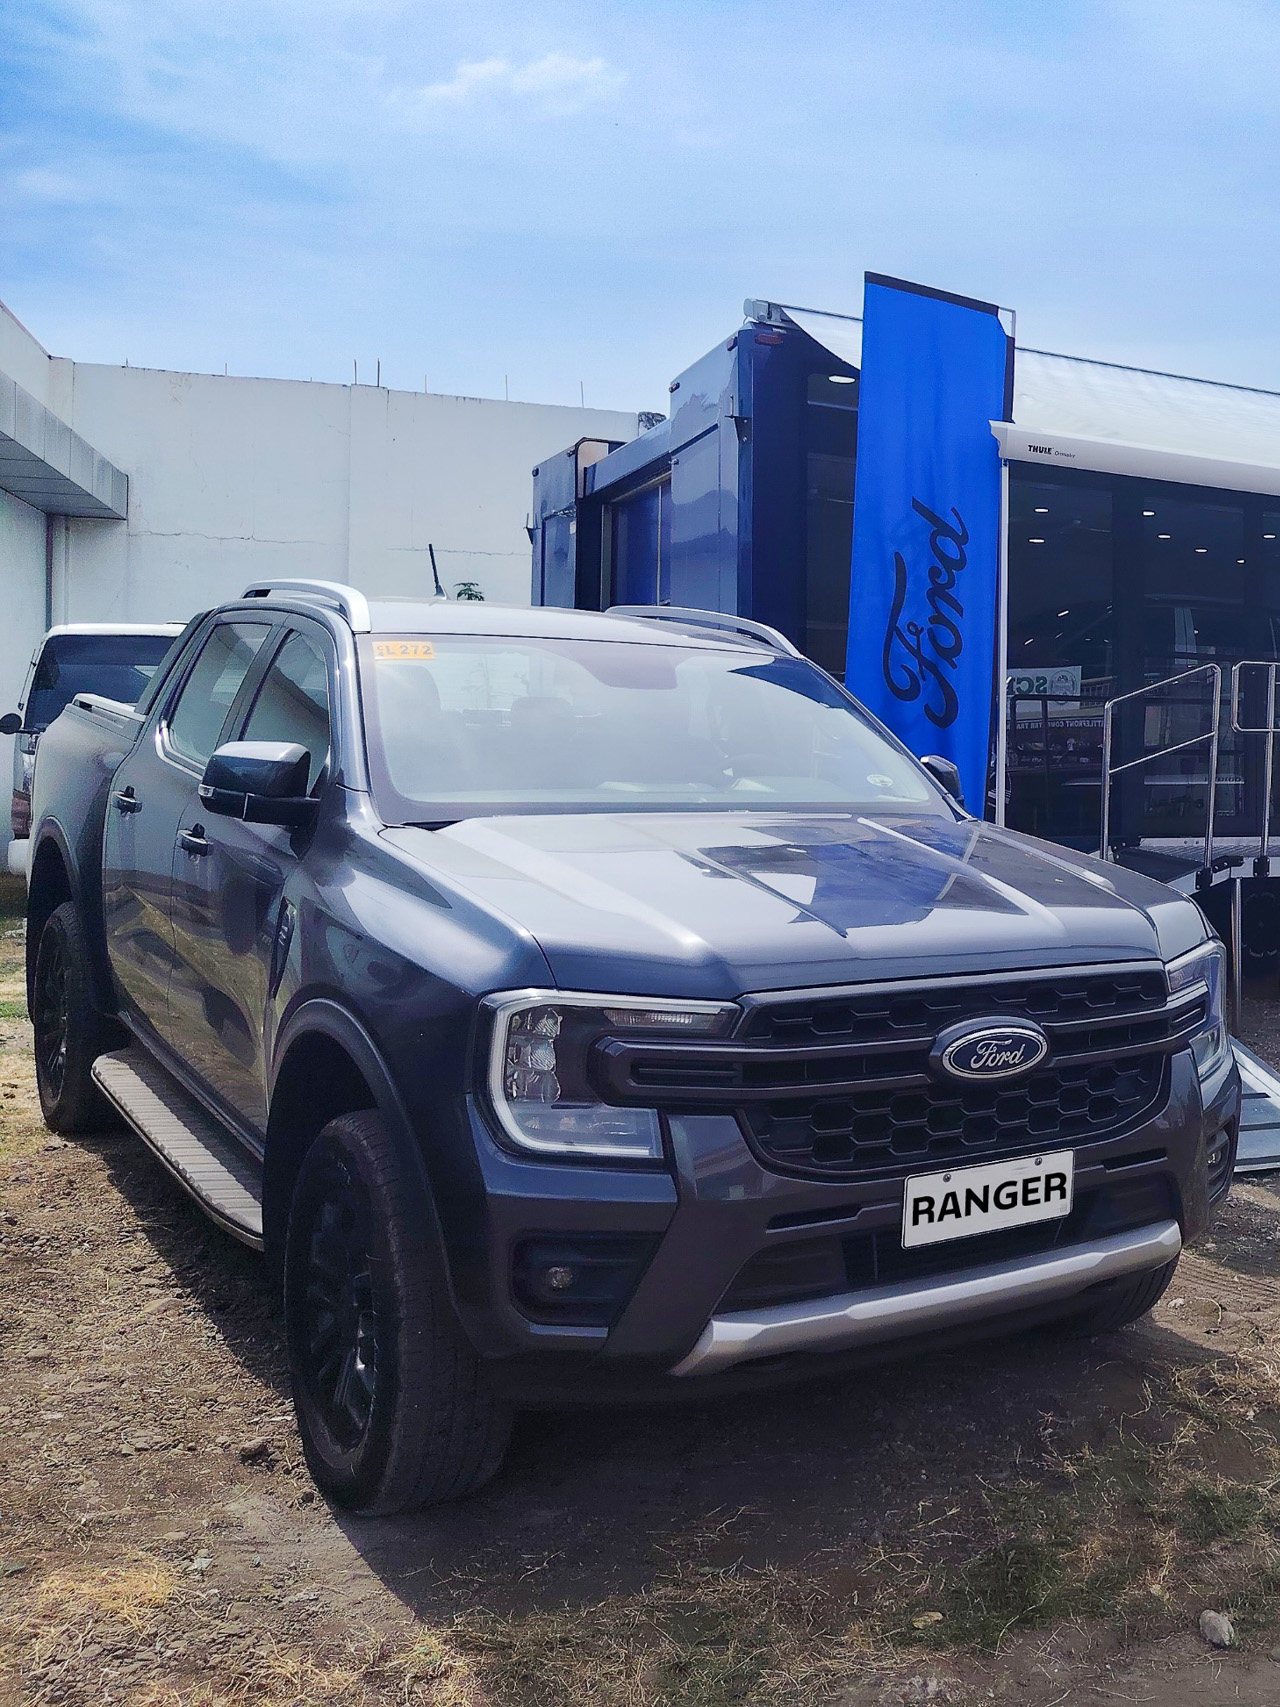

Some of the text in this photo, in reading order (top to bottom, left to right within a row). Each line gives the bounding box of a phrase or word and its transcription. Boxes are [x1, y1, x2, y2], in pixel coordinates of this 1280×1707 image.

[1028, 444, 1052, 455] THULE
[883, 496, 970, 730] Ford
[970, 1038, 1025, 1069] Ford
[912, 1172, 1067, 1227] RANGER
